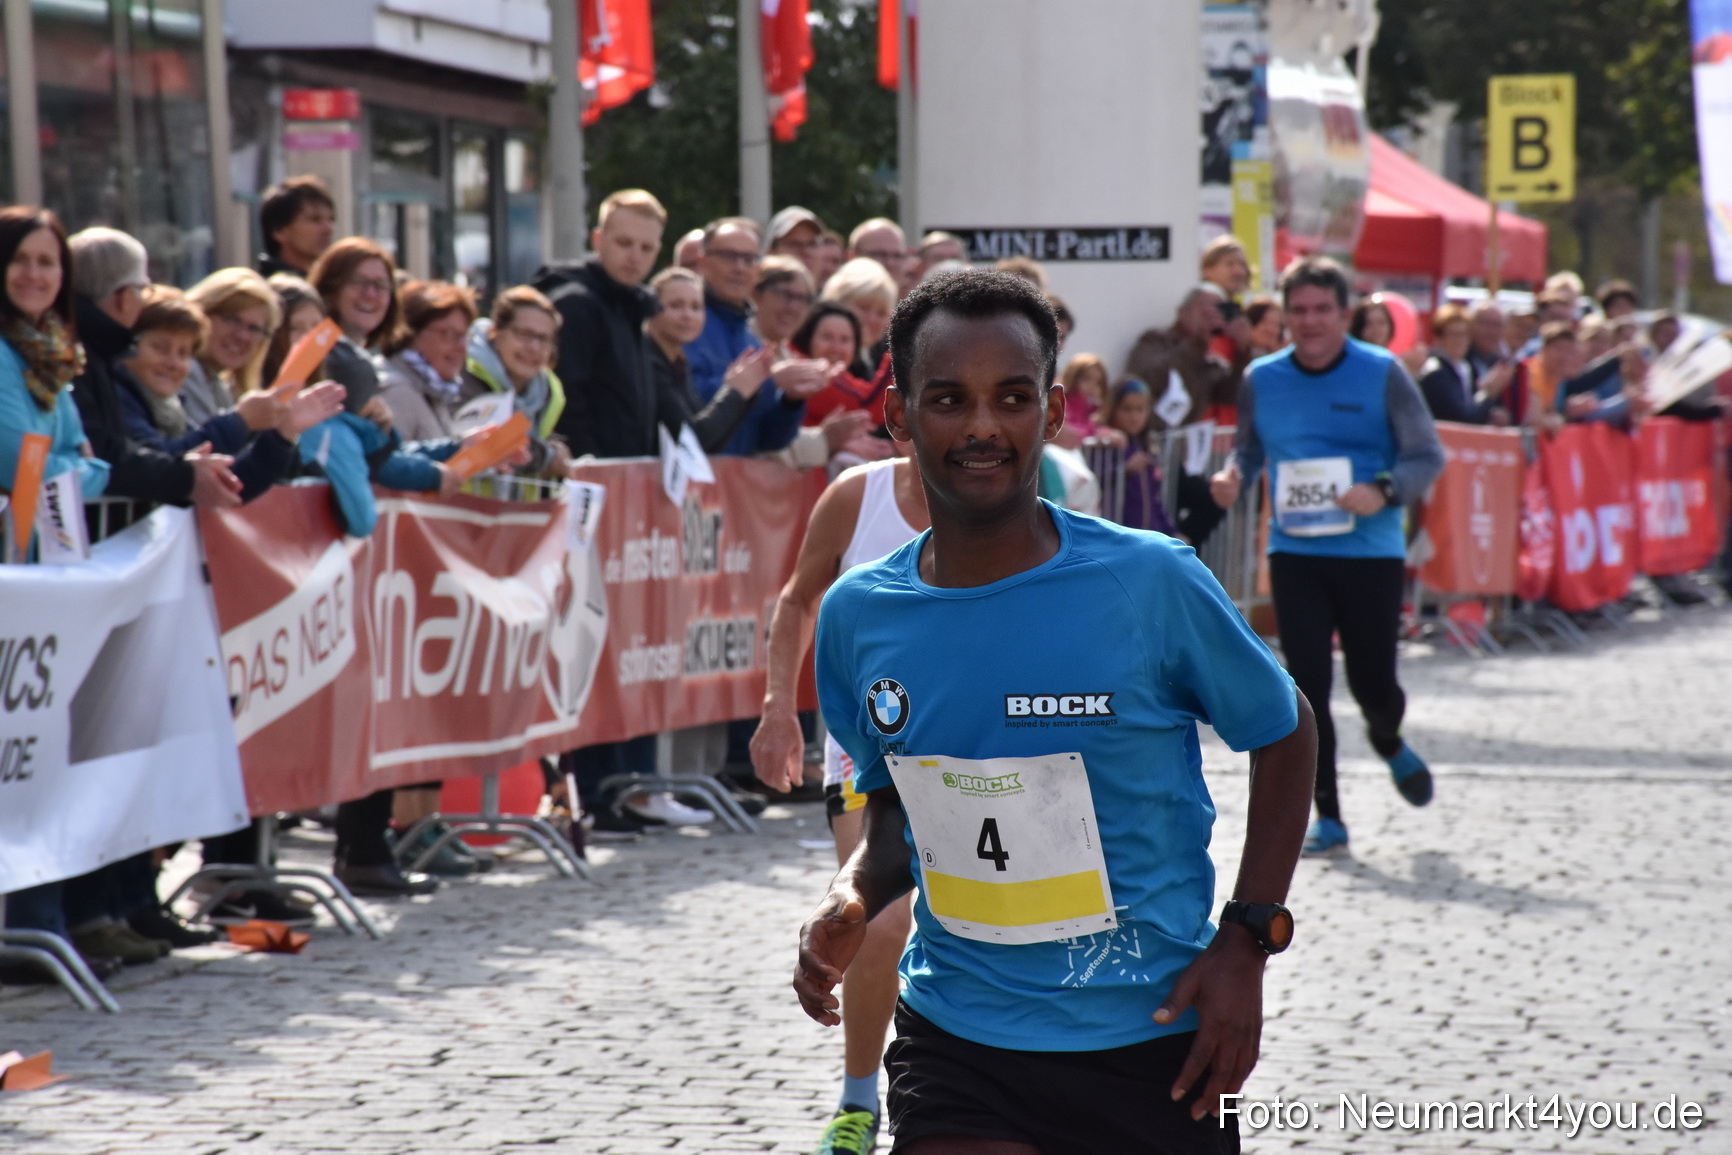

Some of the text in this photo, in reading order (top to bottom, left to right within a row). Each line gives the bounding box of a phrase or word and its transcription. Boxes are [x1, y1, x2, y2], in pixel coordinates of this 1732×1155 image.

[1512, 116, 1551, 171] B
[1286, 483, 1337, 507] 2654
[0, 634, 58, 713] ICS.
[228, 627, 290, 720] DAS
[869, 681, 904, 700] BMW
[1006, 694, 1114, 717] BOCK
[1005, 718, 1118, 729] inspired by smart concepts
[958, 774, 1022, 792] BOCK
[977, 818, 1009, 871] 4
[1079, 937, 1111, 984] September
